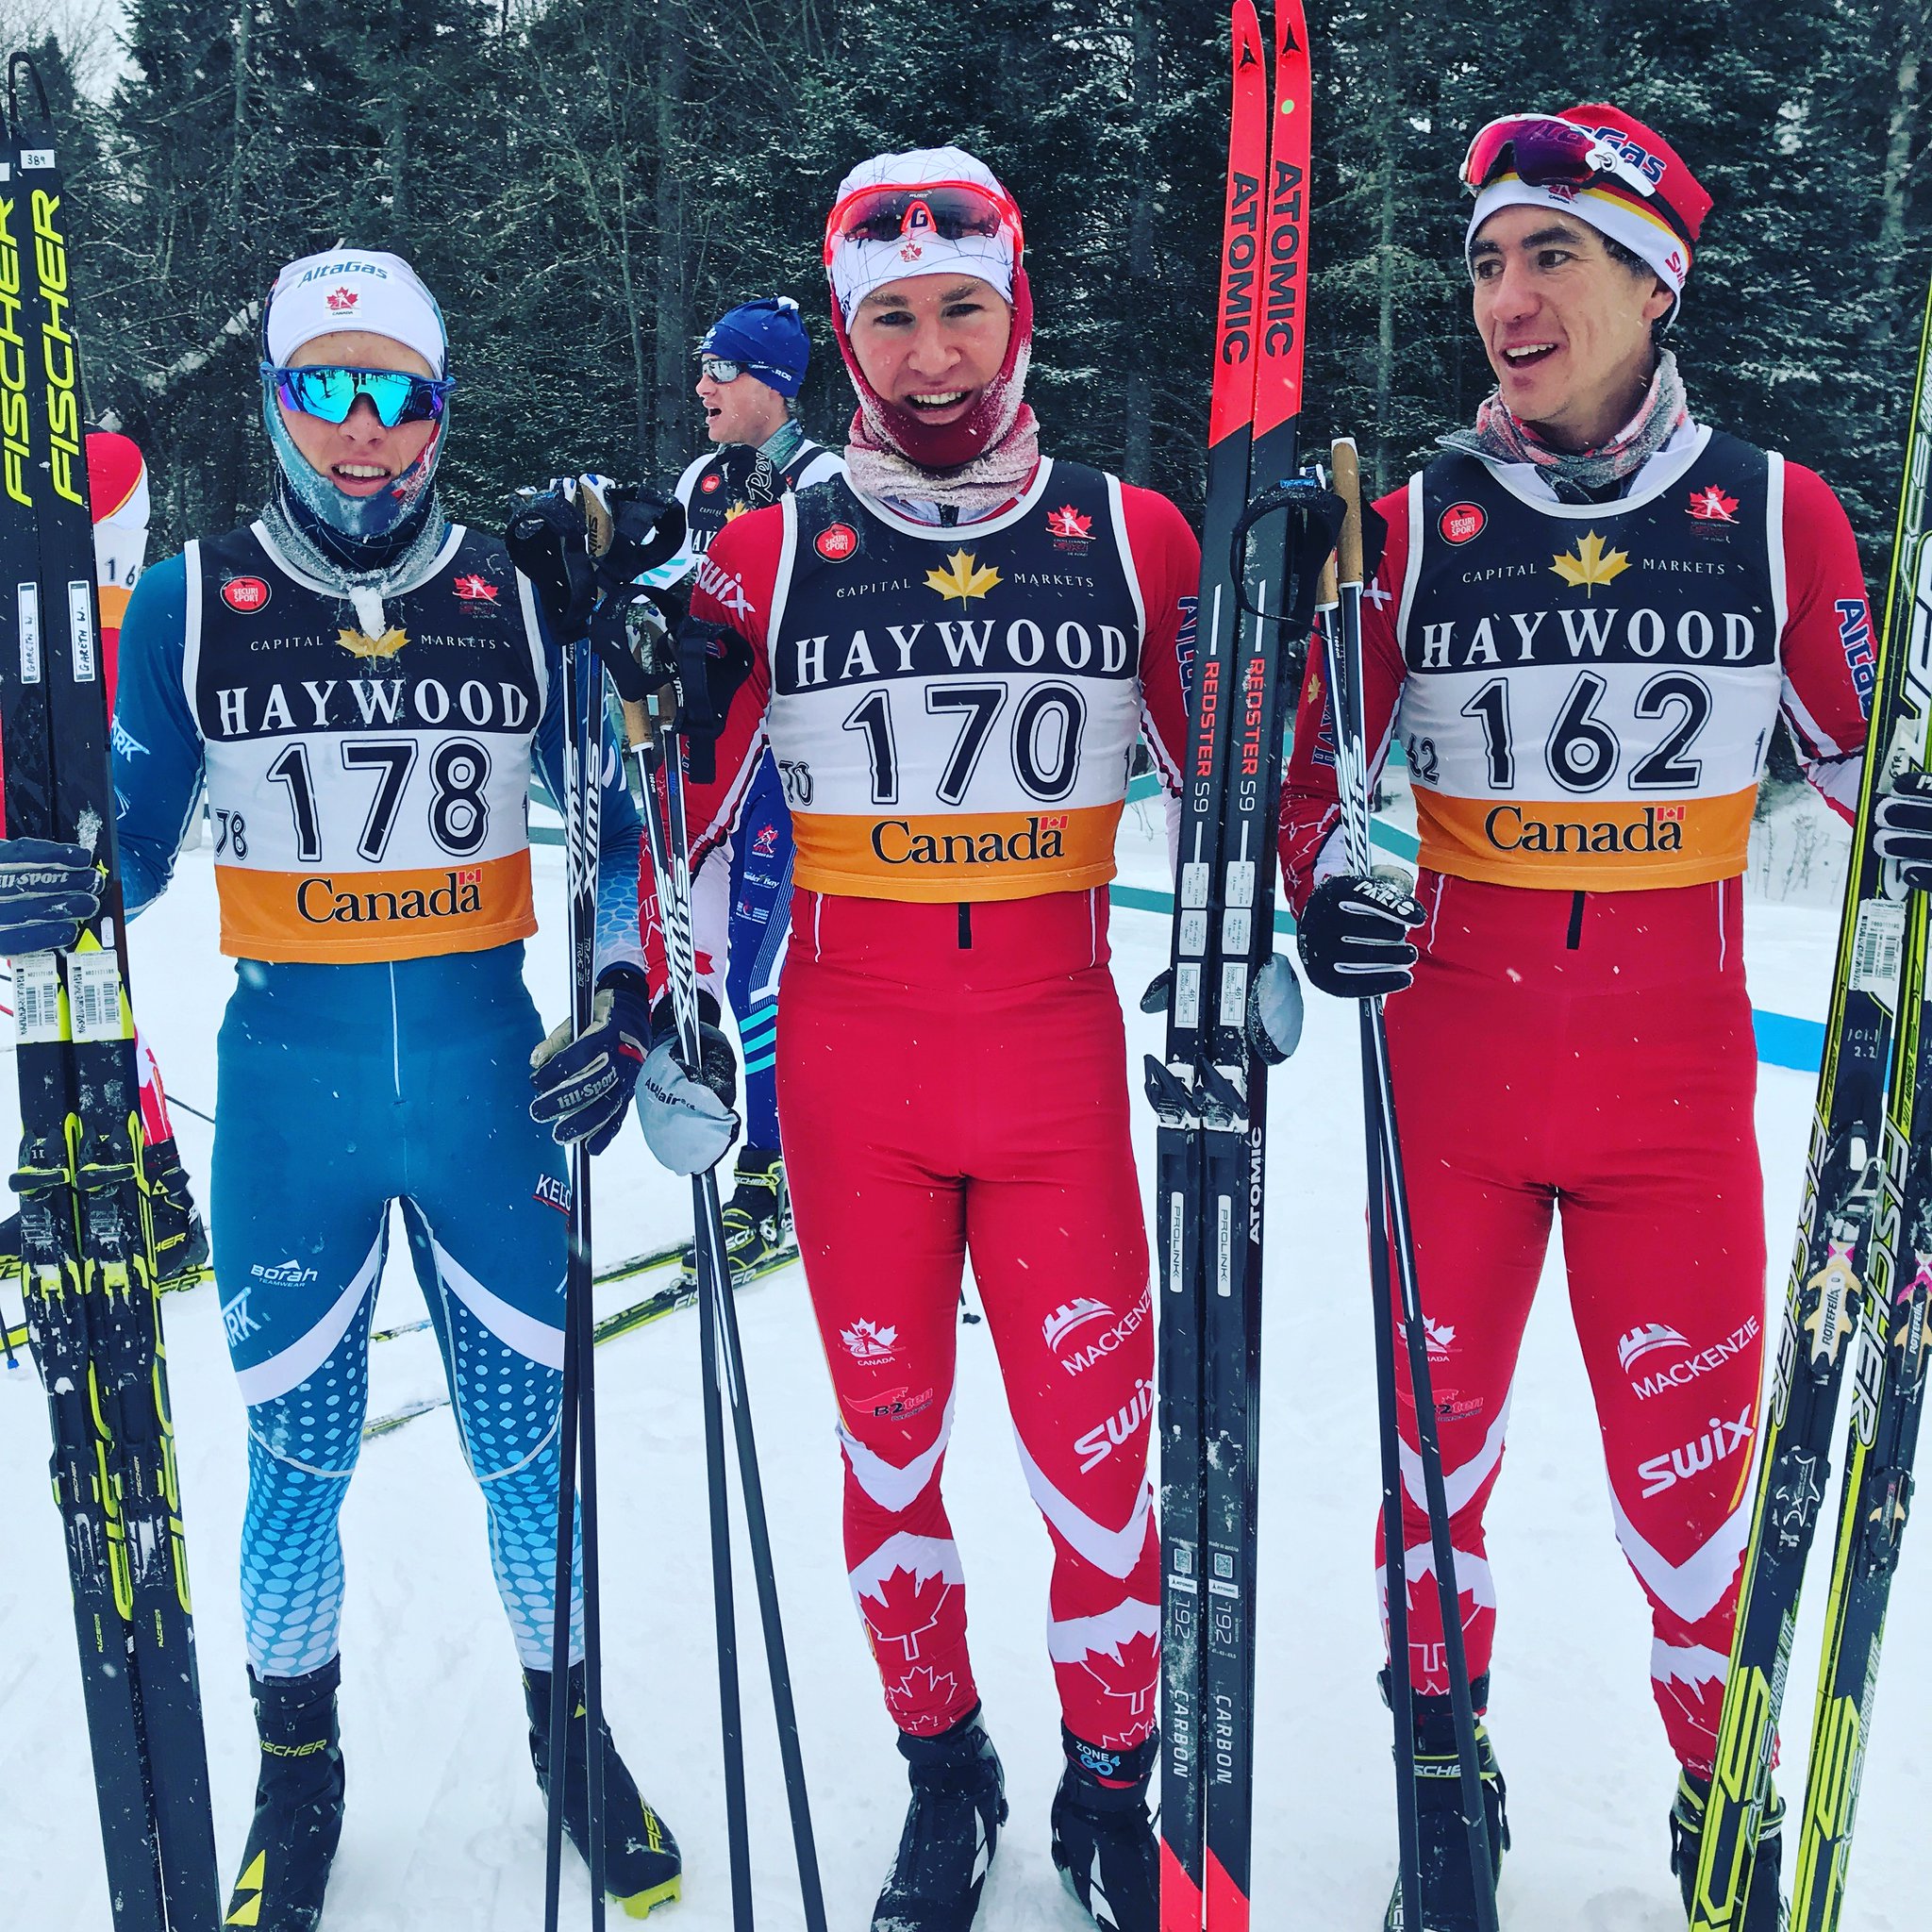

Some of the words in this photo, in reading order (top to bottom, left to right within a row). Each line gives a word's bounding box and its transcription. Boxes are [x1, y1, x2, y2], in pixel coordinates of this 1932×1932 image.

[297, 261, 388, 288] AltaGas
[1223, 171, 1259, 366] ATOMIC
[1265, 159, 1303, 358] ATOMIC
[31, 189, 83, 506] FISCHER
[824, 541, 849, 552] SPORT
[1450, 516, 1475, 529] SECURI
[1451, 525, 1475, 538] SPORT
[232, 587, 259, 596] SECURI
[836, 578, 911, 599] CAPITAL
[1014, 573, 1094, 589] MARKETS
[1462, 562, 1538, 584] CAPITAL
[1642, 558, 1725, 575] MARKETS
[233, 594, 259, 604] SPORT
[77, 629, 92, 672] GARETH
[250, 636, 324, 651] CAPITAL
[421, 634, 496, 650] MARKETS
[795, 618, 1128, 689] HAYWOOD
[1420, 608, 1756, 669] HAYWOOD
[216, 678, 529, 736] HAYWOOD
[1196, 661, 1221, 777] REDSTER
[1241, 658, 1265, 775] REDSTER
[841, 679, 1088, 806] 170
[1459, 669, 1713, 794] 162
[266, 736, 492, 863] 178
[1193, 781, 1210, 813] S9
[1239, 780, 1257, 812] S9
[871, 816, 1065, 864] Canada
[1484, 805, 1683, 854] Canada
[297, 872, 483, 924] Canada
[1854, 1045, 1876, 1059] 2.2
[1249, 1125, 1262, 1245] ATOMIC
[1173, 1205, 1181, 1277] PROLINK
[1220, 1208, 1228, 1283] PROLINK
[250, 1263, 319, 1282] Borah
[258, 1277, 306, 1288] TEAMWEAR
[1851, 1119, 1911, 1448] FISCHER
[857, 1357, 896, 1366] CANADA
[1631, 1314, 1761, 1401] MACKENZIE
[71, 1460, 80, 1504] FISCHER
[134, 1456, 143, 1498] FISCHER
[1174, 1600, 1191, 1640] 192
[1215, 1604, 1232, 1644] 192
[1173, 1689, 1189, 1778] CARBON
[1215, 1694, 1232, 1784] CARBON
